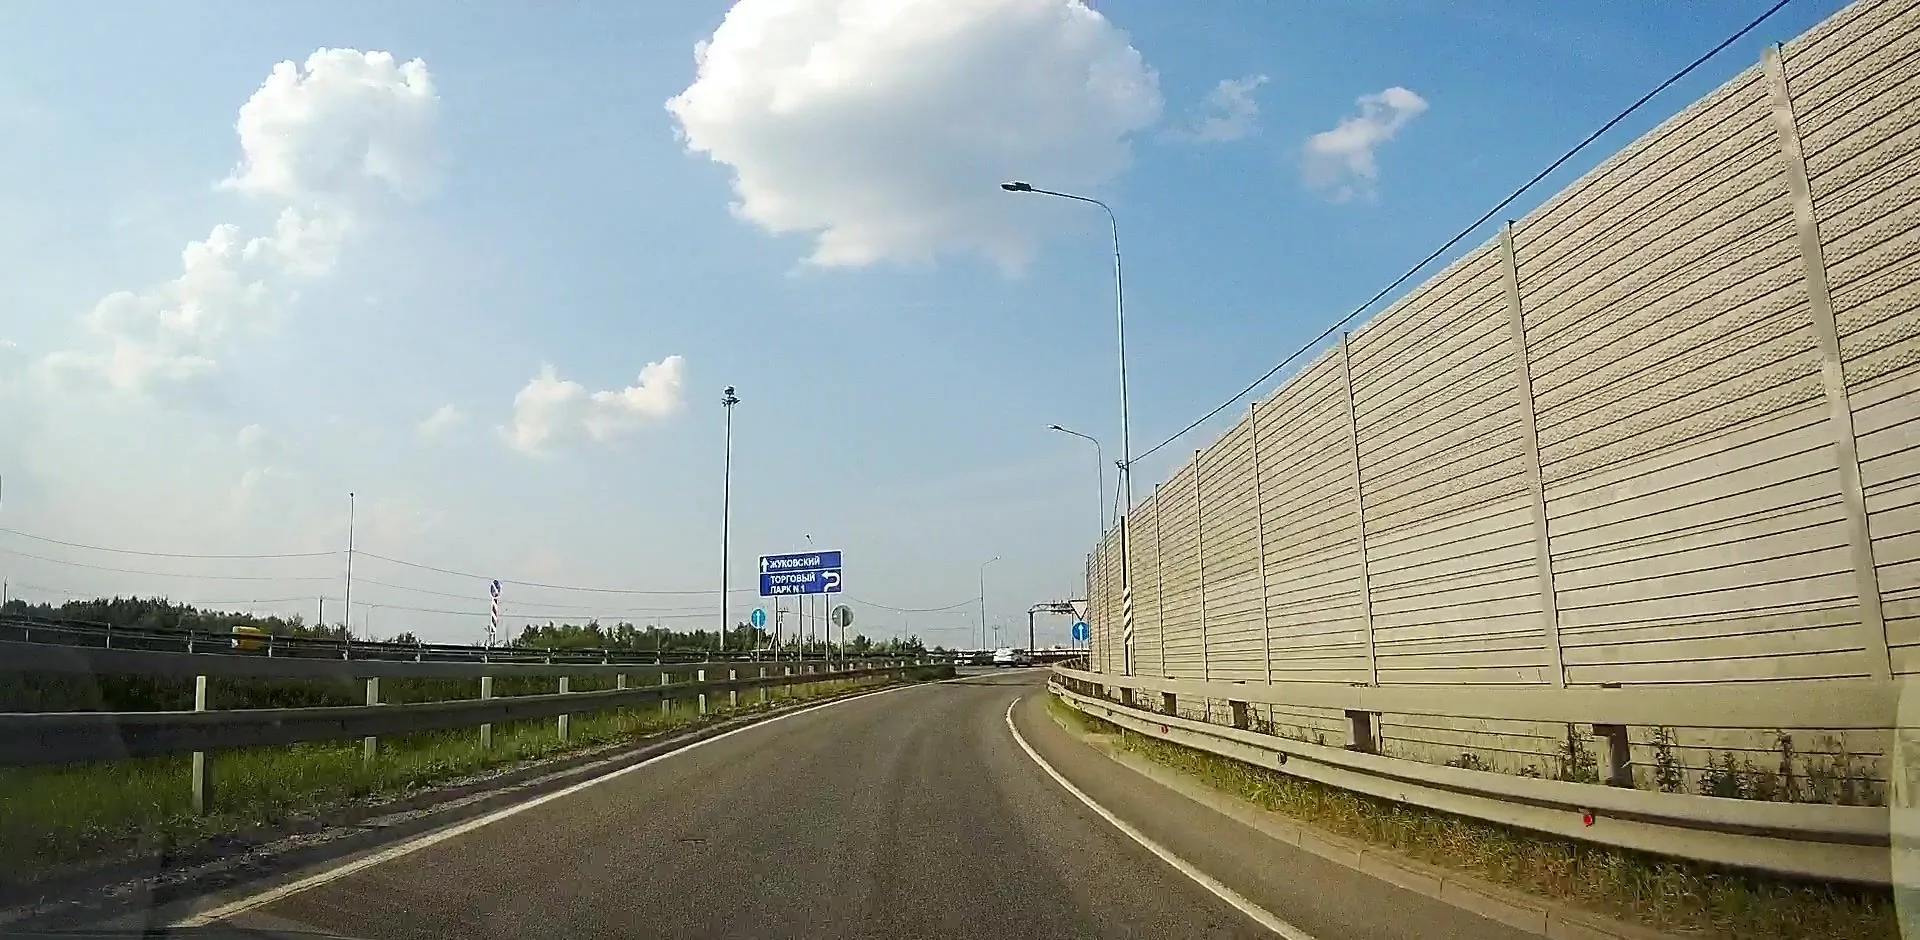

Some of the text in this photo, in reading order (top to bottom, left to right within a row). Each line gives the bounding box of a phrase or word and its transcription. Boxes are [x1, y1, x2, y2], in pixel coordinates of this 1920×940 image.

[769, 556, 820, 568] ЖУКОВСКИЙ
[770, 572, 816, 584] ТОРГОВЫЙ
[770, 585, 792, 594] ПАРК
